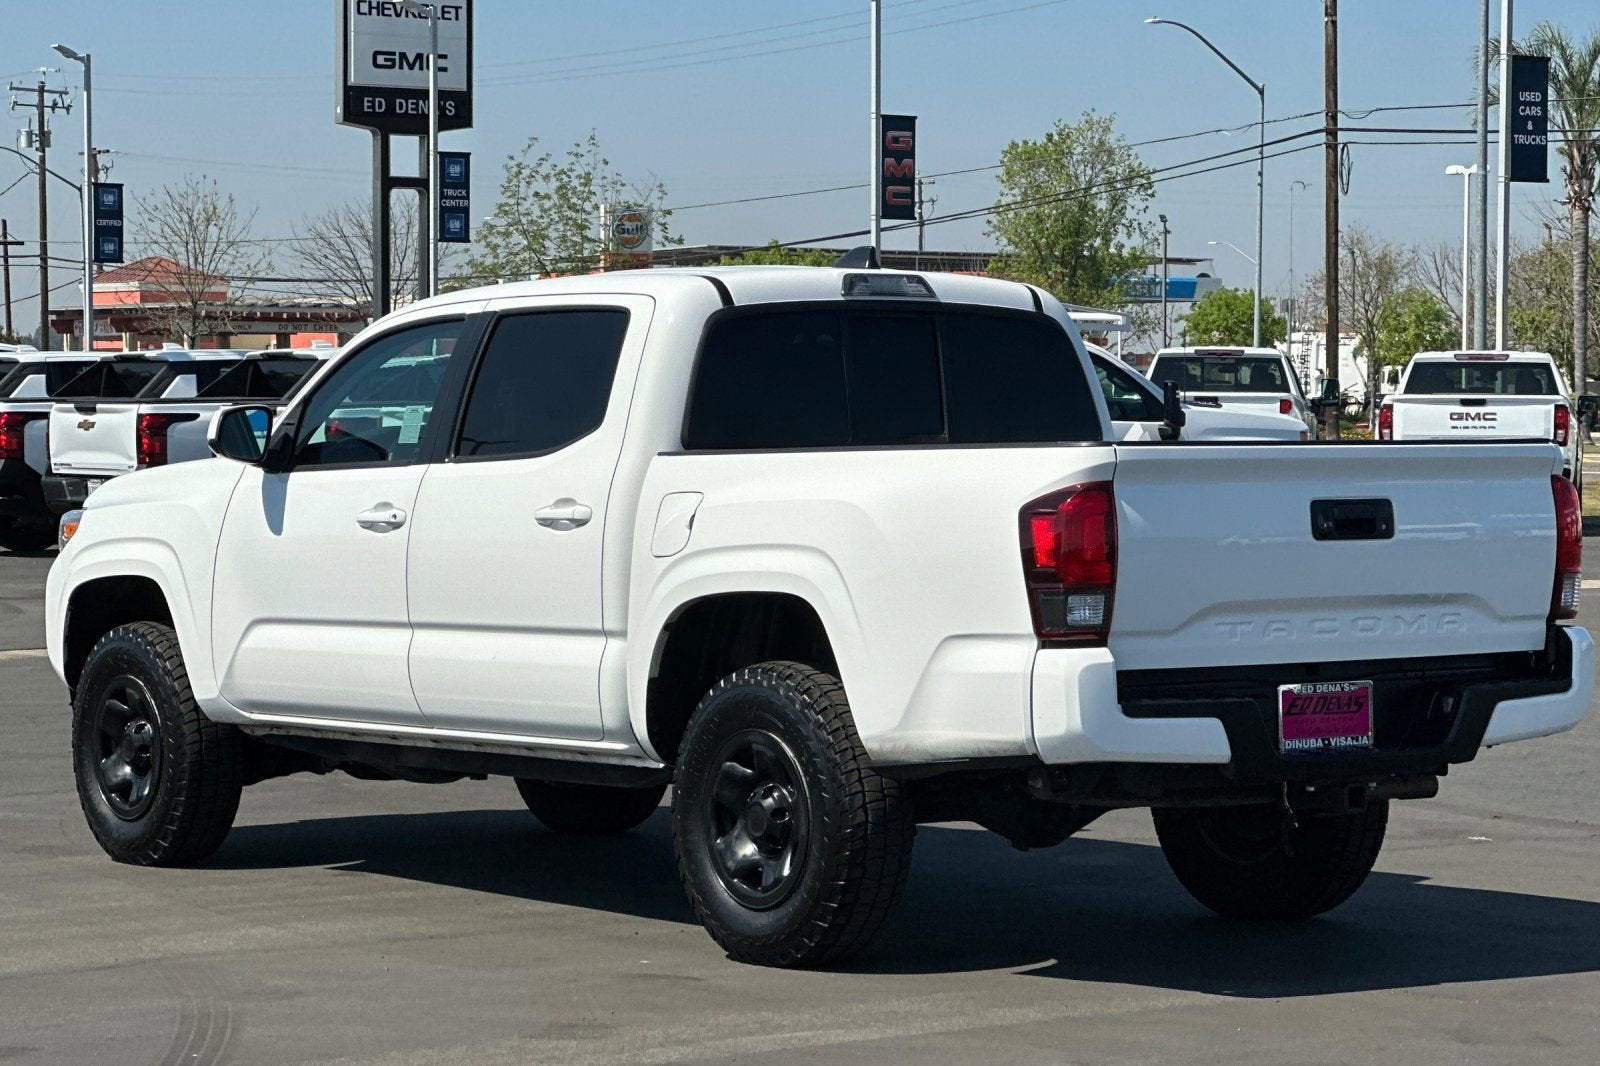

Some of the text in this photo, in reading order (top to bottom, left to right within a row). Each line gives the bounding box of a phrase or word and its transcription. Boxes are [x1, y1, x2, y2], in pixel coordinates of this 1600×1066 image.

[356, 0, 462, 21] CHEVROET
[372, 50, 448, 72] GMC
[1519, 91, 1541, 102] USED
[363, 97, 456, 116] ED DEN'S
[1519, 106, 1542, 116] CARS
[1526, 120, 1533, 130] &
[1513, 134, 1547, 145] TRUCKS
[884, 130, 915, 206] GMC
[443, 188, 467, 197] TRUCK
[441, 199, 469, 207] CENTER
[96, 219, 122, 227] CERTIFIED
[278, 323, 338, 331] DO NOT ENTER
[1449, 412, 1498, 421] GMC
[1215, 612, 1468, 641] TACOMA
[1302, 683, 1350, 693] ED DENA'S
[1285, 735, 1369, 749] DINUBA VISALIA
